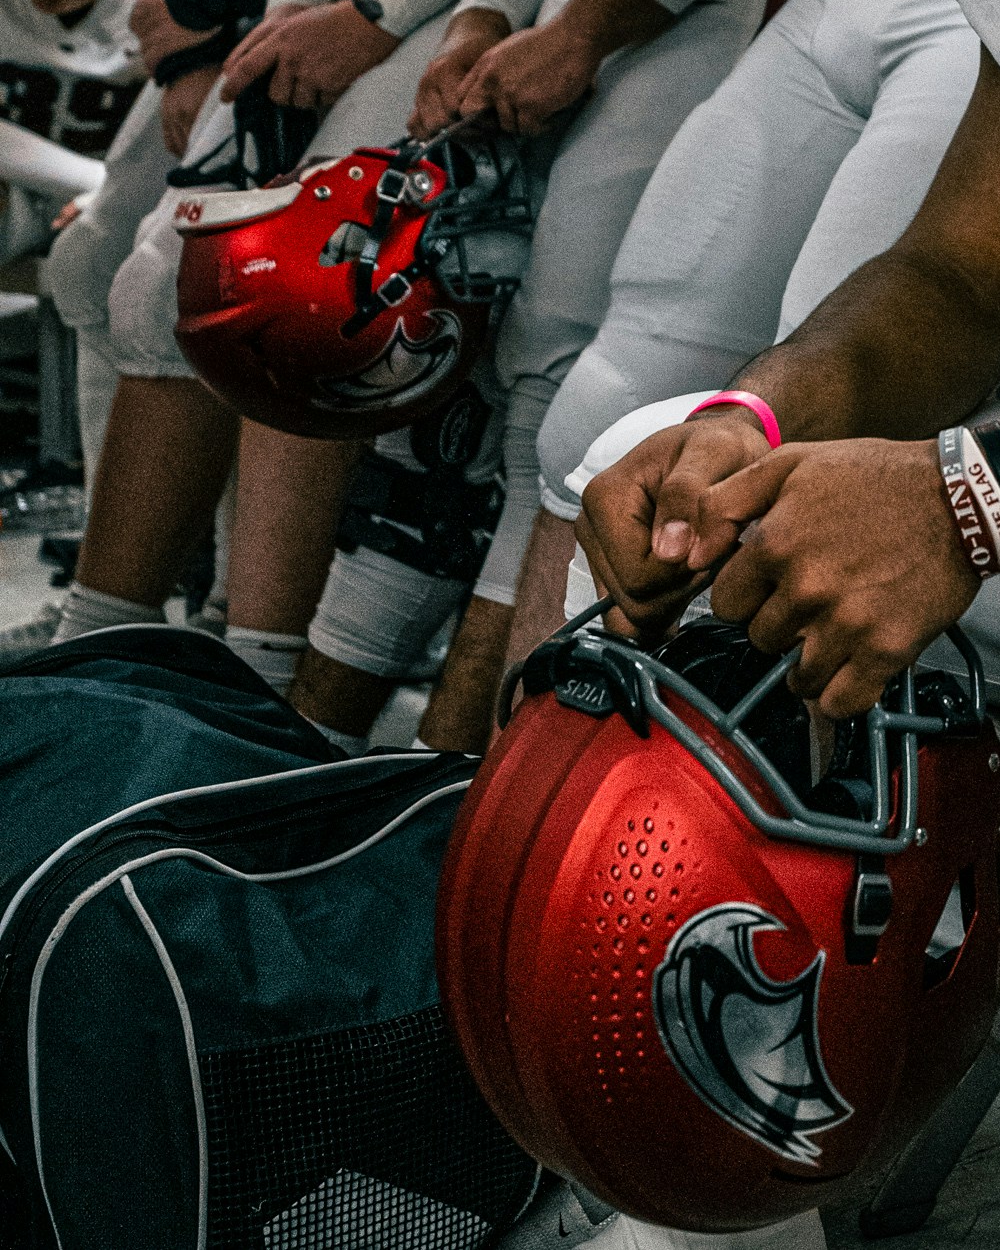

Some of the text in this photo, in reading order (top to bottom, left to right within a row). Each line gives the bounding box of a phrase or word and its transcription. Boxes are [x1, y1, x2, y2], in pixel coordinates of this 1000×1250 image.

[968, 462, 1000, 507] FLAG
[942, 462, 991, 567] O-LINE
[563, 679, 606, 706] VICIS
